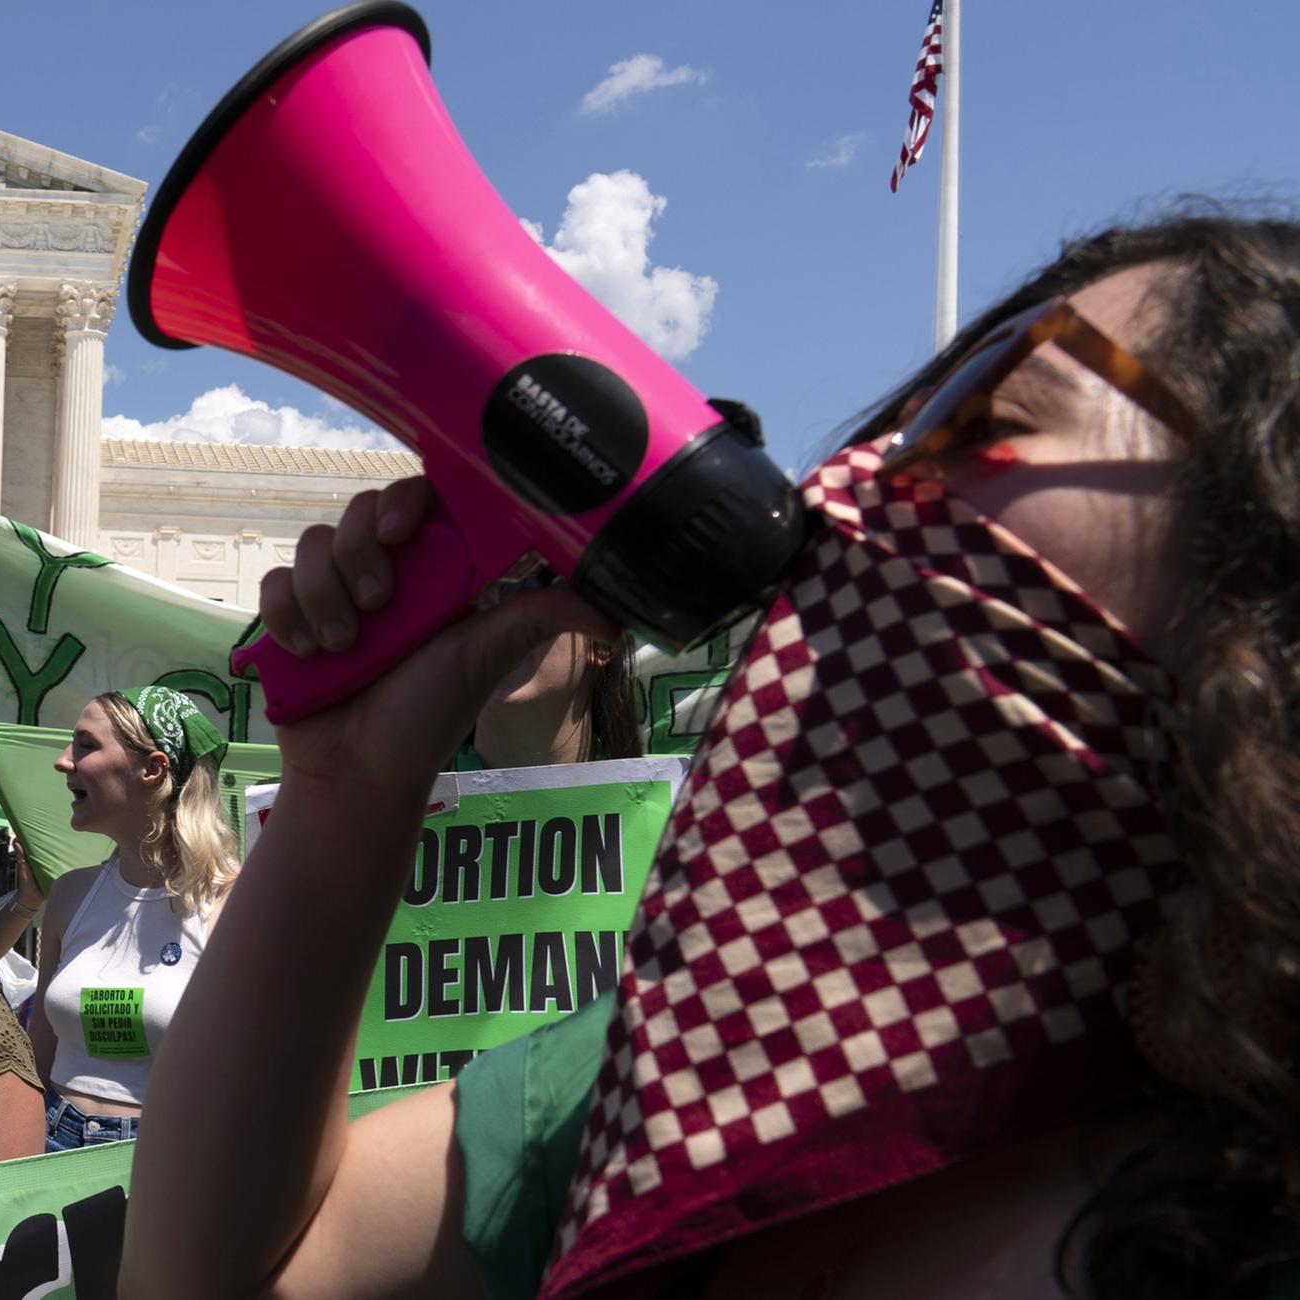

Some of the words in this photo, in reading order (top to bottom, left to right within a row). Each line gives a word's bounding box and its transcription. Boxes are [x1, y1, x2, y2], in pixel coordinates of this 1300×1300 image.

[515, 373, 567, 423] BASTA
[563, 415, 590, 436] DE
[402, 812, 623, 907] ORTION
[384, 929, 630, 1023] DEMAN
[128, 989, 134, 1001] A
[84, 1003, 131, 1015] SOLICITADO
[134, 1003, 140, 1015] Y
[91, 1017, 105, 1029] SIN
[108, 1017, 132, 1029] PEDIR
[89, 1031, 137, 1042] DISCULPAS!
